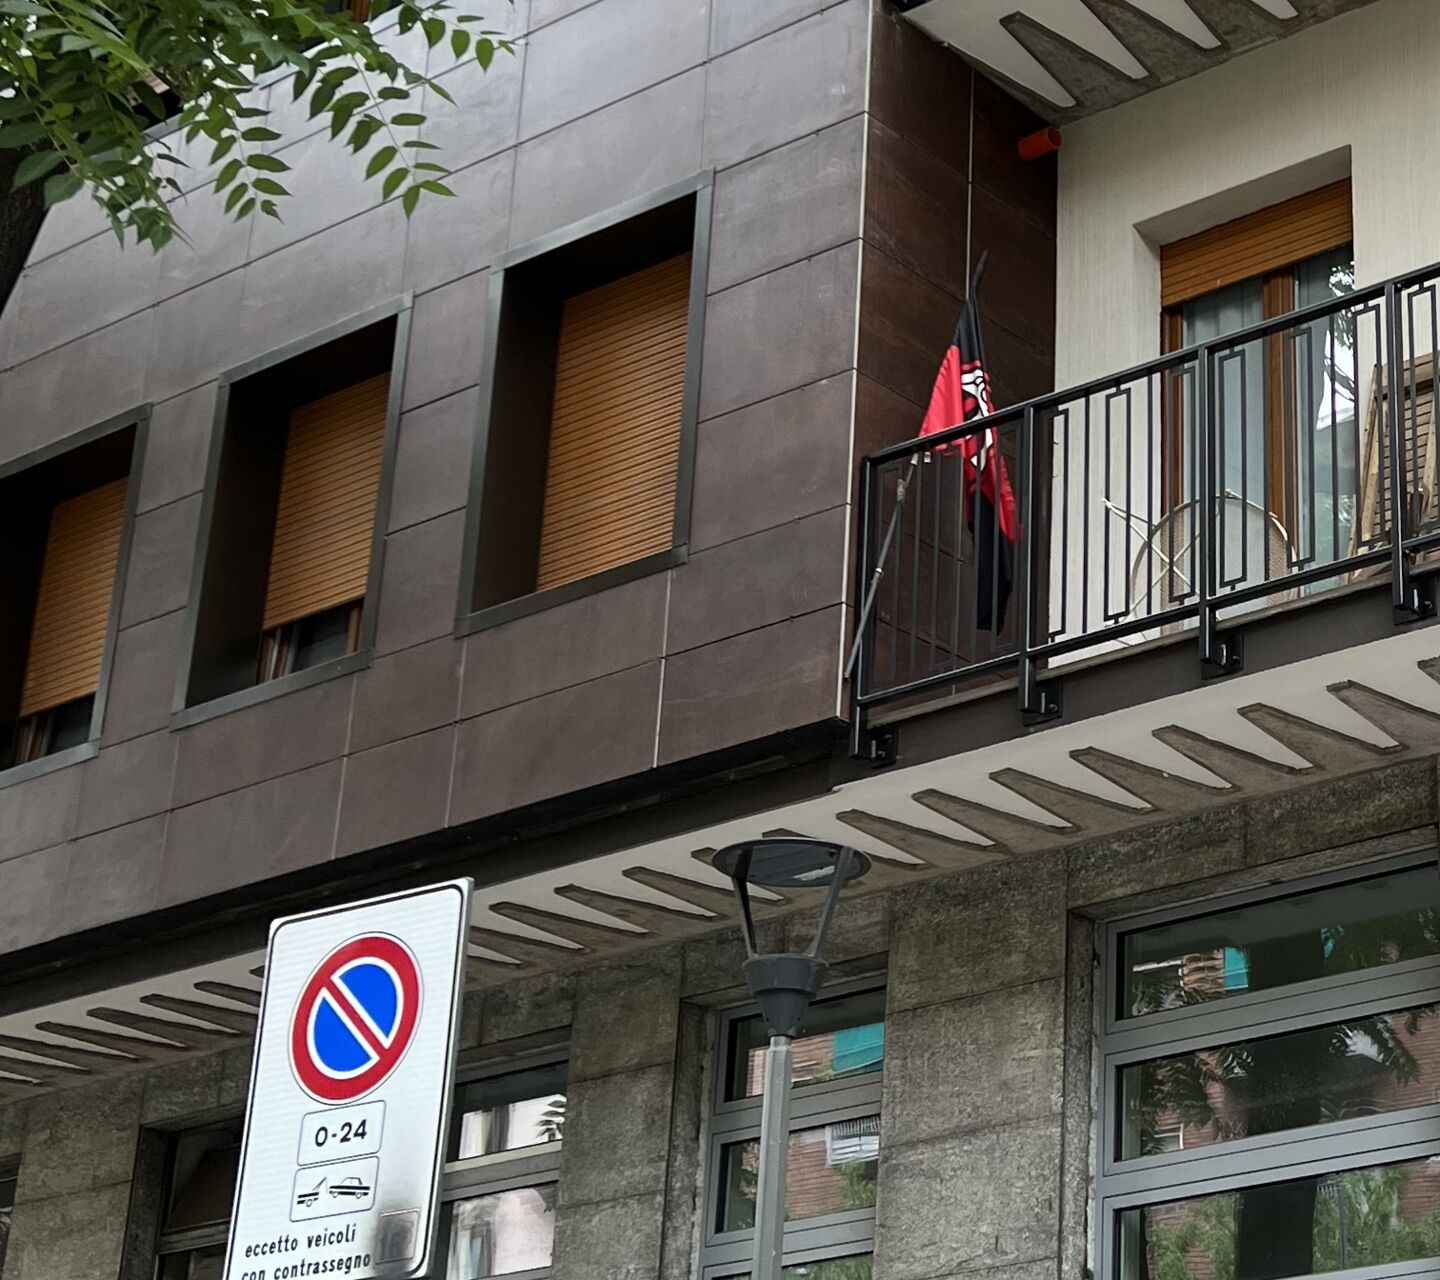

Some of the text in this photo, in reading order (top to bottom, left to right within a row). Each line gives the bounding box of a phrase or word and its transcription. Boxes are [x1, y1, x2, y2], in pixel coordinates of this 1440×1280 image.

[314, 1119, 368, 1148] 0-24
[245, 1223, 357, 1258] eccetto veicoli
[273, 1253, 372, 1280] contrassegno
